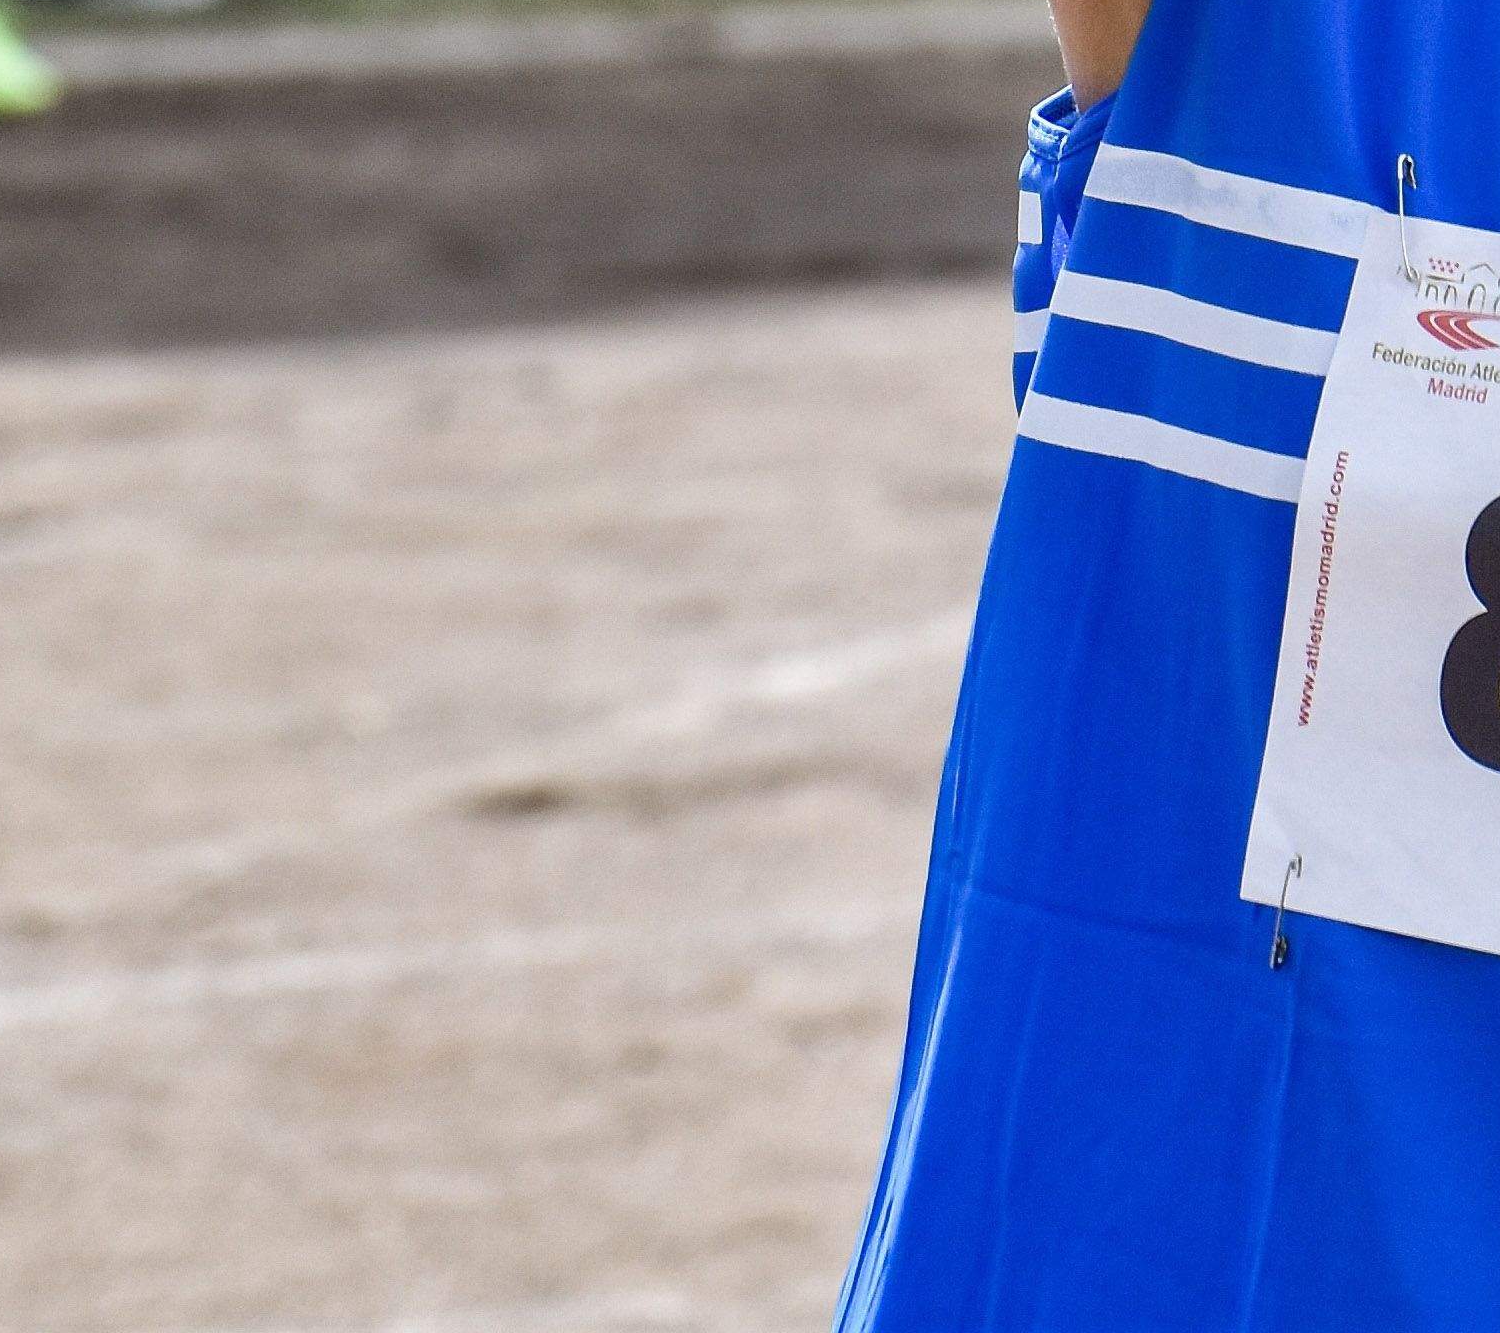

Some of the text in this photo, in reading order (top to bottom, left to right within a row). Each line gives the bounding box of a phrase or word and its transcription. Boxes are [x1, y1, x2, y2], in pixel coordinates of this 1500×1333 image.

[1372, 342, 1467, 378] Federación
[1427, 377, 1489, 405] Madrid
[1297, 449, 1350, 727] www.atletismomadrid.com
